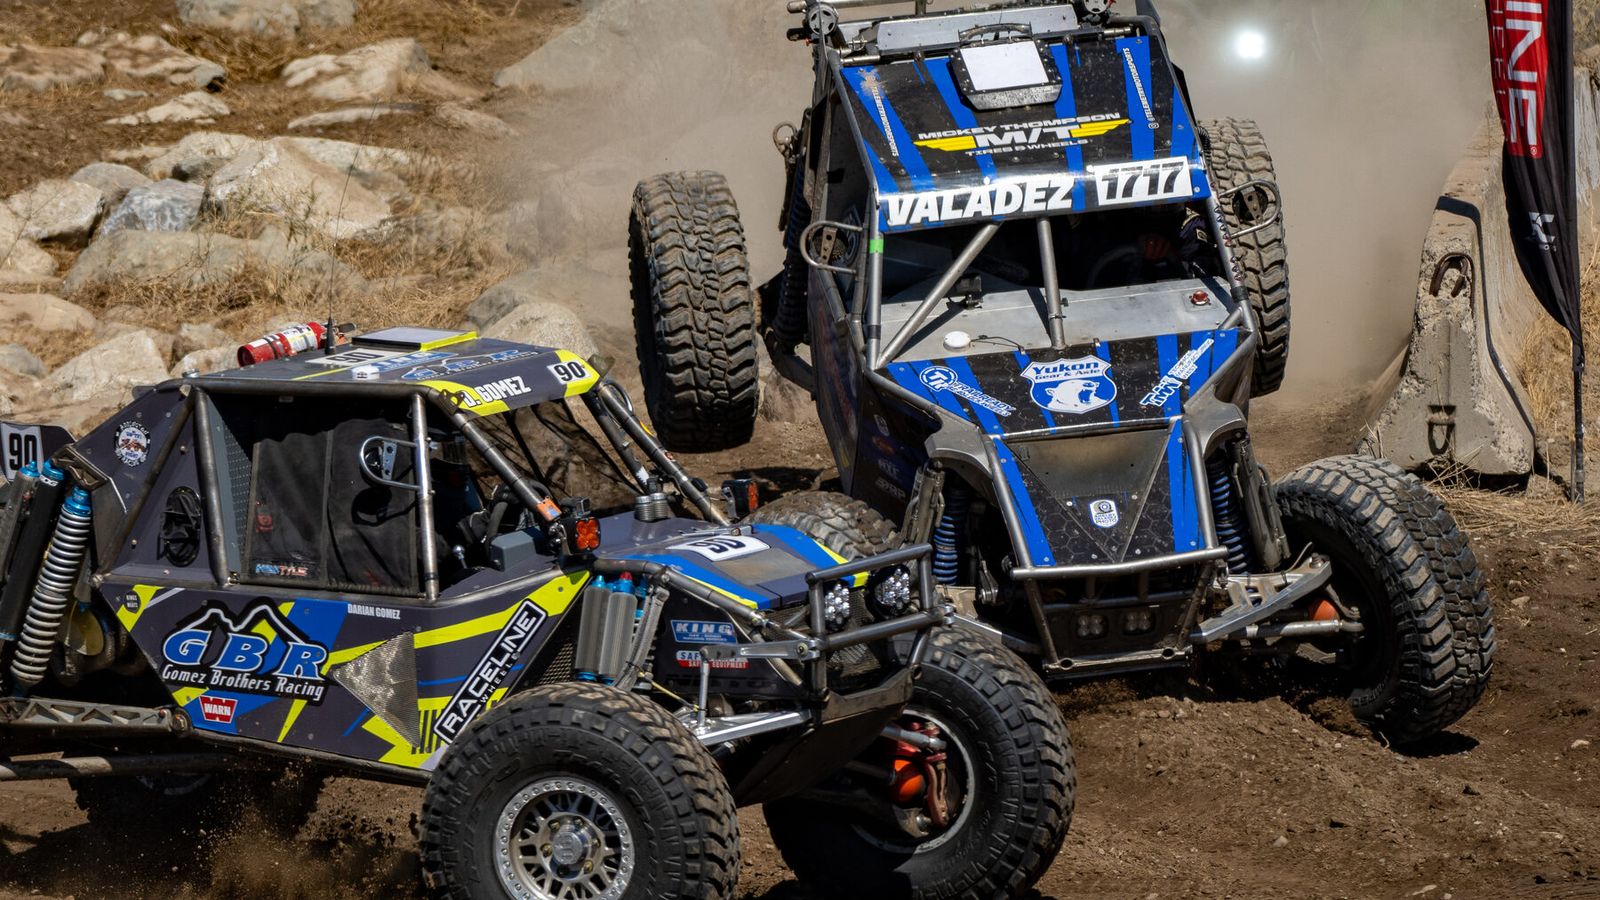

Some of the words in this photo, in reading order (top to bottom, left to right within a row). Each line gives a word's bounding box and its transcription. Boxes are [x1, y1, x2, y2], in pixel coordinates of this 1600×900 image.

[918, 126, 997, 140] MICKEY
[1000, 112, 1120, 130] THOMPSON
[973, 125, 1080, 148] M/T
[965, 147, 1013, 157] TIRES
[1026, 139, 1088, 150] WHEELS
[1100, 159, 1186, 202] 1717
[887, 176, 1076, 226] VALADEZ
[553, 361, 586, 382] 90
[1032, 362, 1099, 375] Yukon
[474, 375, 532, 403] GOMEZ
[9, 432, 37, 470] 90
[688, 538, 746, 553] 90
[347, 604, 375, 615] DARIAN
[376, 607, 400, 619] GOMEZ
[676, 623, 733, 635] KING
[163, 630, 326, 680] GBR
[162, 664, 204, 683] Gomez
[212, 669, 271, 691] Brothers
[276, 676, 324, 699] Racing
[442, 611, 536, 733] RACELINE
[204, 703, 231, 716] WARN
